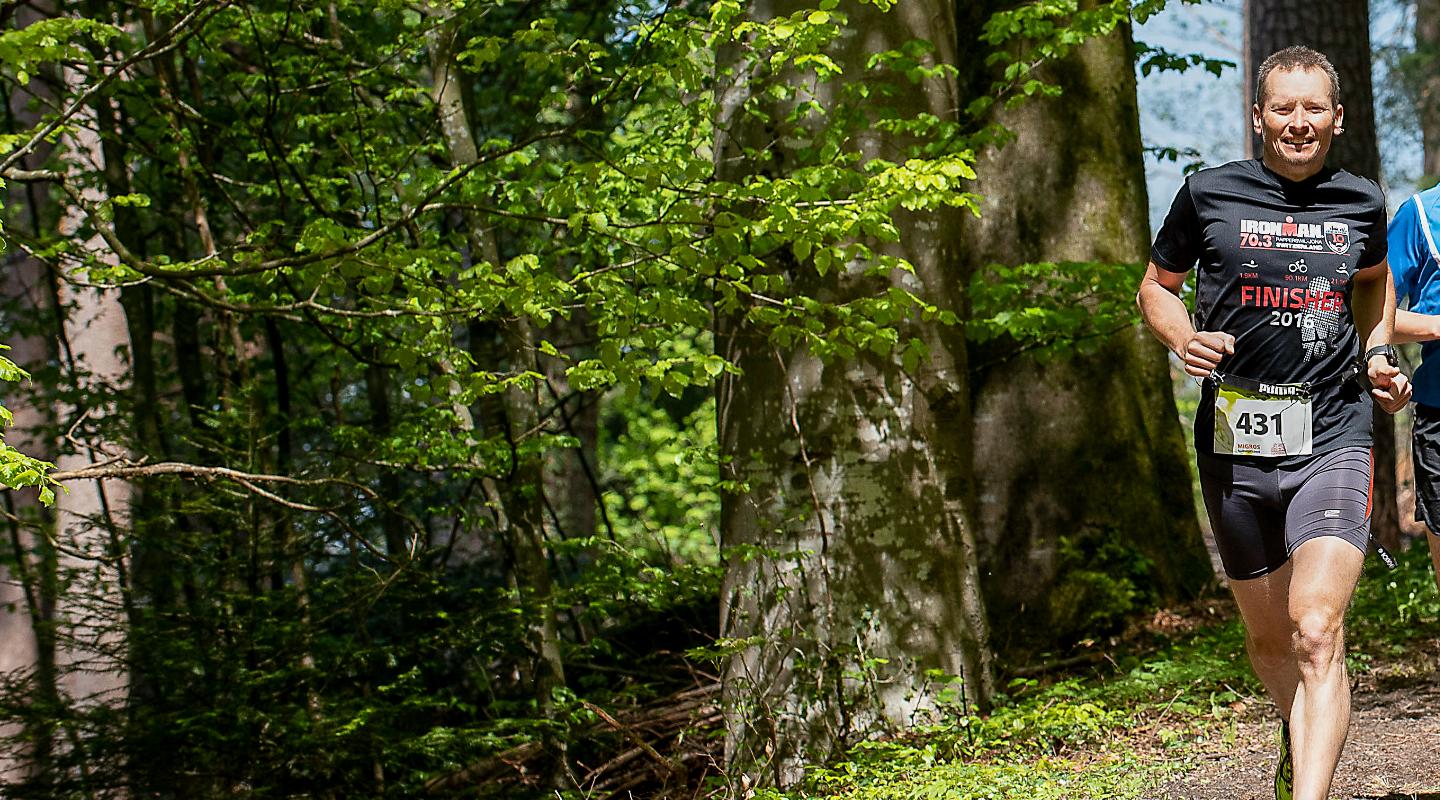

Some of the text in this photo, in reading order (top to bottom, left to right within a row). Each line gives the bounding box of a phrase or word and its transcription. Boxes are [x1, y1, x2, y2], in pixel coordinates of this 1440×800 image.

[1240, 219, 1323, 239] IRONMAN
[1240, 232, 1273, 248] 70.3
[1275, 242, 1323, 250] SWITZERLAND
[1241, 286, 1345, 312] FINISHER
[1269, 311, 1315, 328] 2016
[1236, 412, 1282, 435] 431
